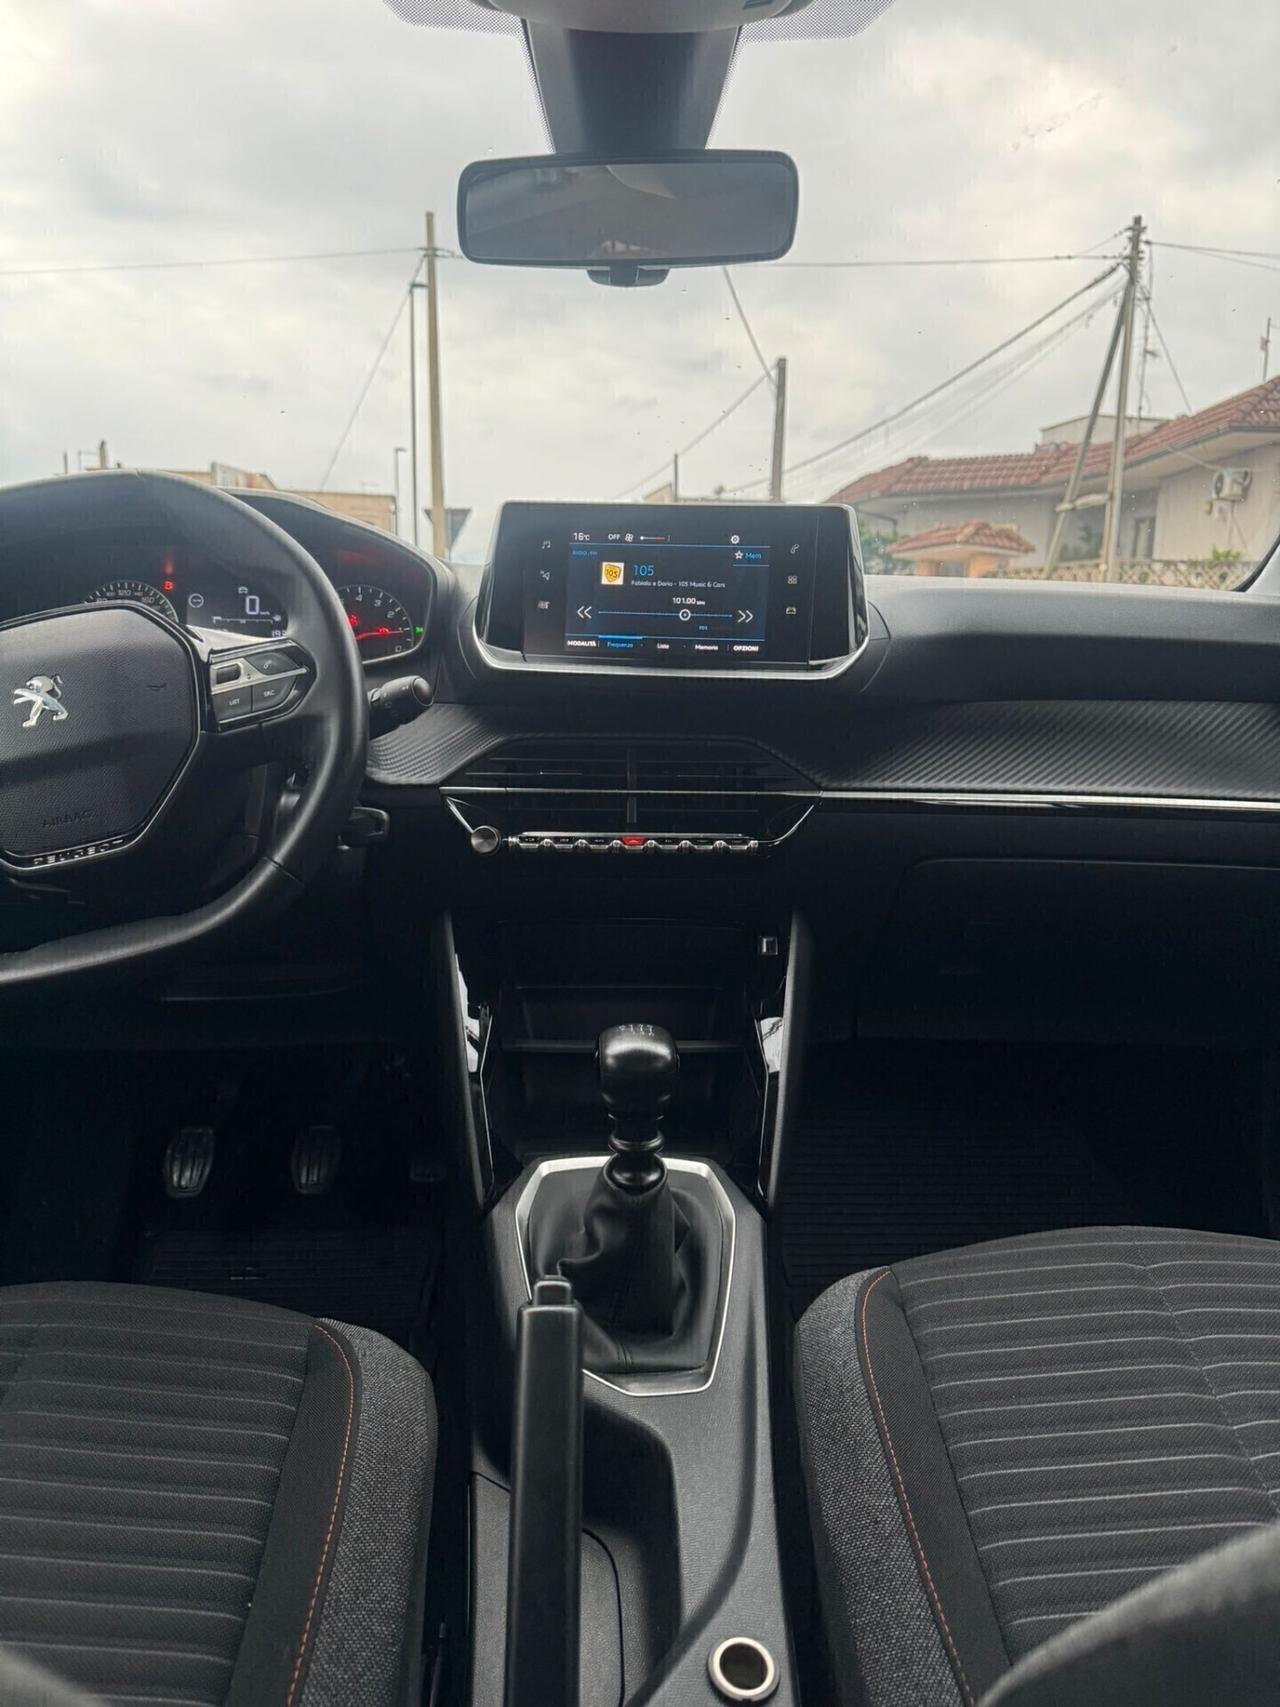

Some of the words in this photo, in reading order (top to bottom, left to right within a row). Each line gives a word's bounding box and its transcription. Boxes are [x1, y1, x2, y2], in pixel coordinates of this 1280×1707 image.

[608, 533, 621, 541] OFF
[606, 568, 619, 578] 105
[633, 565, 655, 576] 105
[355, 594, 363, 602] 4
[672, 597, 697, 605] 101.00
[245, 595, 260, 615] 0
[374, 599, 382, 607] 3
[386, 610, 395, 619] 2
